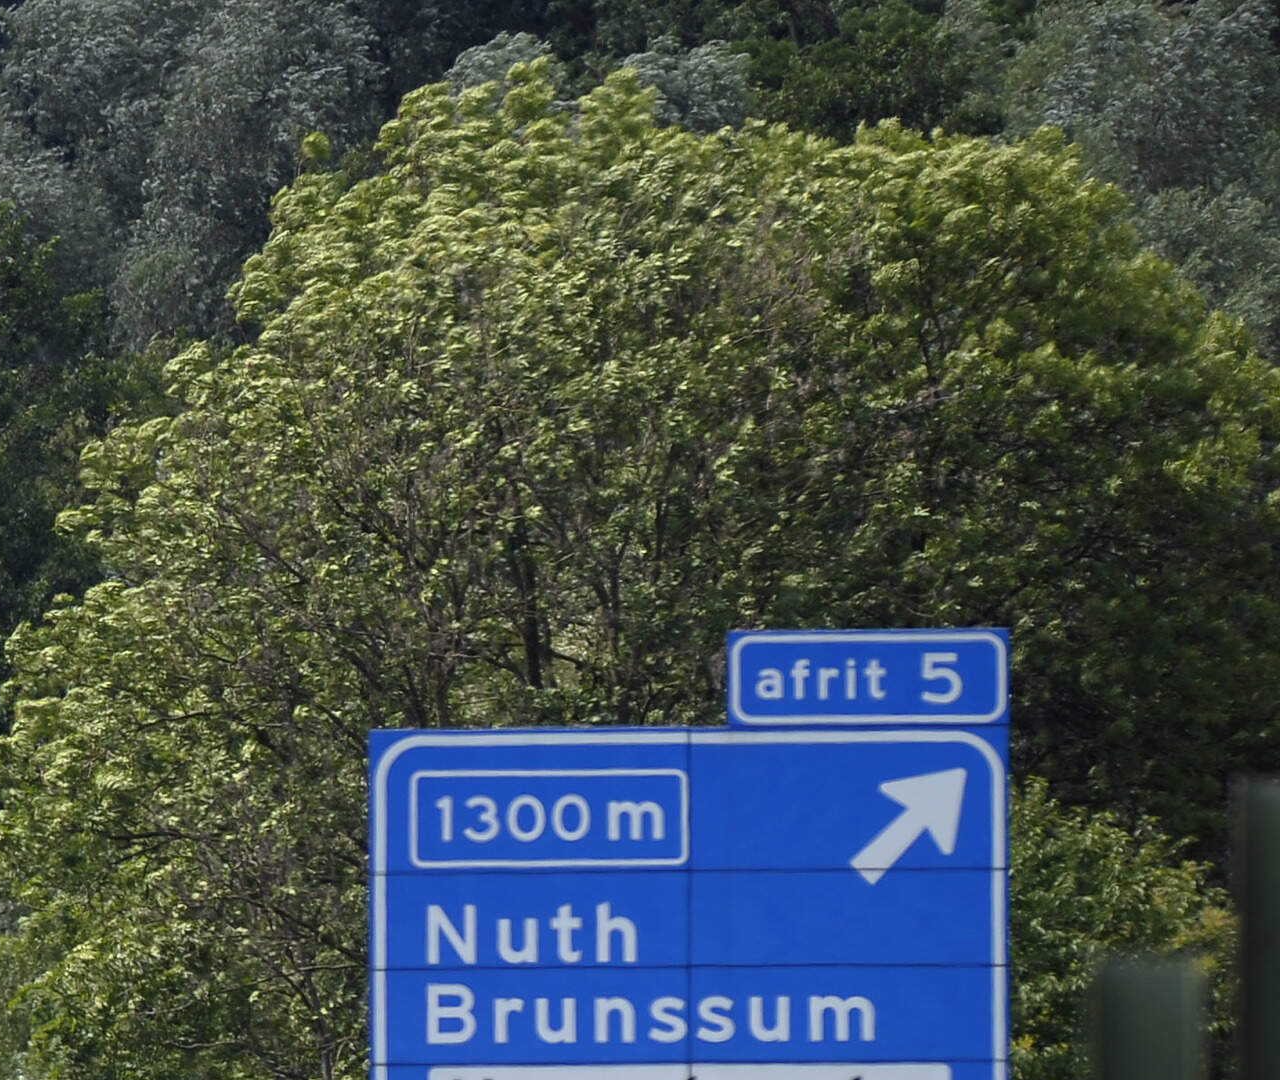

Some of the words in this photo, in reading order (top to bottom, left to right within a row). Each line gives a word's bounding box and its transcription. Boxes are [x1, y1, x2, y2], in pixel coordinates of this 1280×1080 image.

[755, 657, 887, 700] afrit
[920, 652, 964, 704] 5
[436, 794, 591, 843] 1300
[607, 801, 666, 841] m
[426, 902, 637, 965] Nuth
[426, 983, 876, 1045] Brunssum
